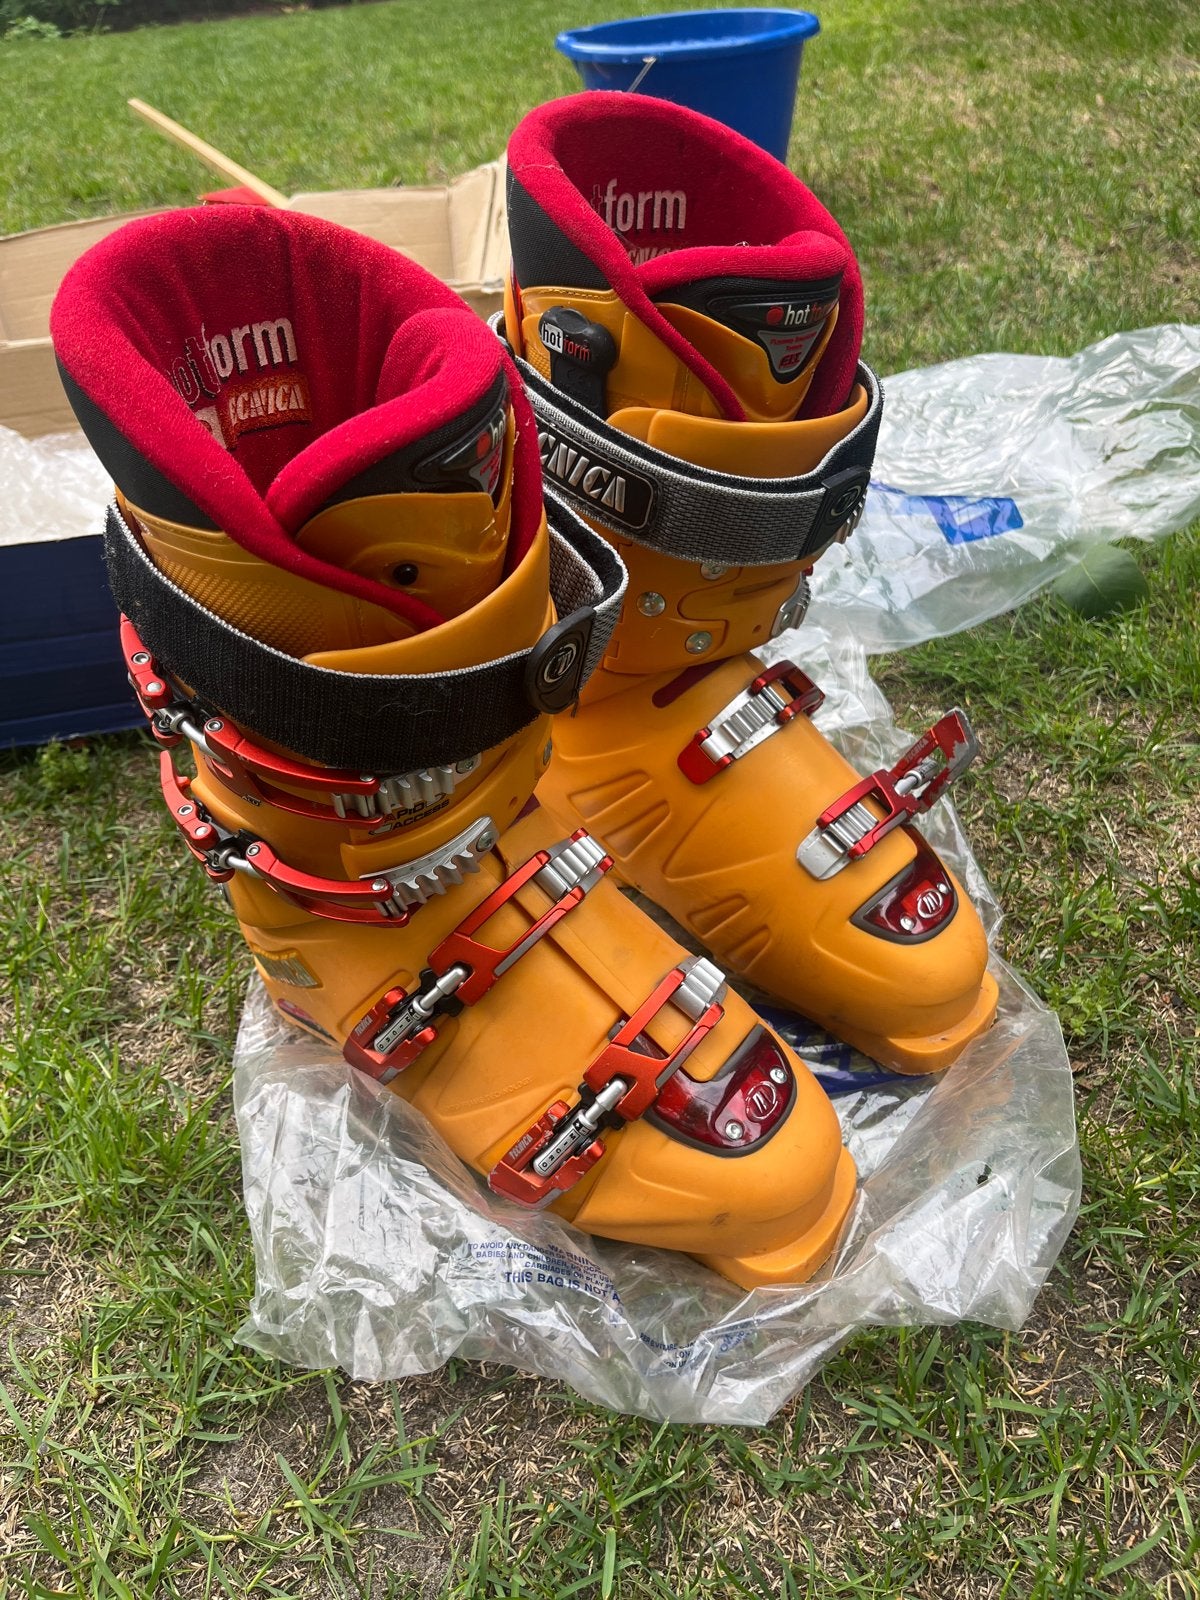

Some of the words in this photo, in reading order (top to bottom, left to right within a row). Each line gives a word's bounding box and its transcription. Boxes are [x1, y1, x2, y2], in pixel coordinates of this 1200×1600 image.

[538, 432, 626, 513] CNICA
[385, 801, 426, 821] APID
[392, 799, 450, 830] ACCESS
[508, 1133, 534, 1160] TECNICA
[476, 1250, 506, 1258] BABIES
[480, 1241, 504, 1249] AVOID
[505, 1242, 521, 1250] ANY
[505, 1271, 533, 1283] THIS
[537, 1272, 564, 1288] BAG
[568, 1278, 580, 1289] IS
[584, 1283, 608, 1297] NOT
